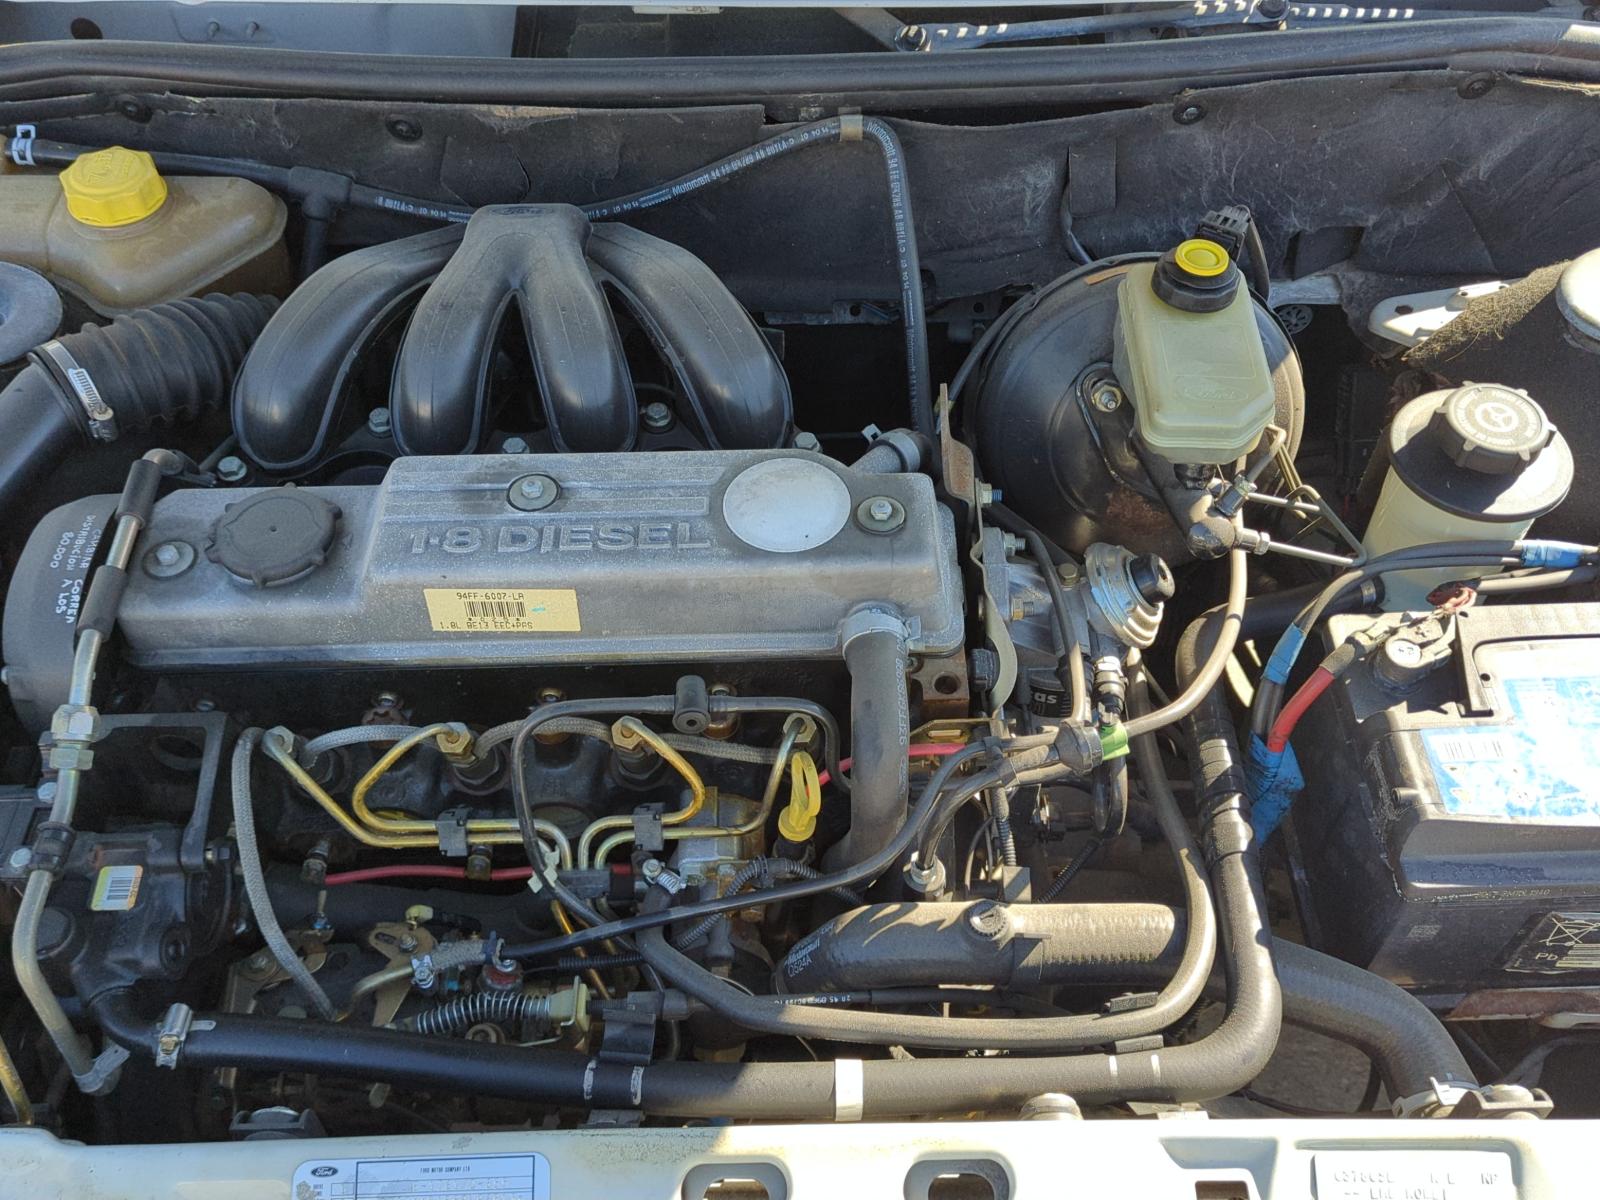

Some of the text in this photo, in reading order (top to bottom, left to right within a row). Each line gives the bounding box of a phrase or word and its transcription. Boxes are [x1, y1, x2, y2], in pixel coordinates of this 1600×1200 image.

[867, 122, 896, 157] Motorcraft
[672, 175, 710, 196] Motorcraft
[498, 522, 711, 553] DIESEL
[50, 531, 74, 568] 80.000
[61, 579, 73, 588] A
[66, 529, 101, 623] CAMBIAR CORREA
[56, 593, 70, 614] LOS
[456, 592, 524, 600] 94FF-6007-LA
[1535, 952, 1558, 961] Pb
